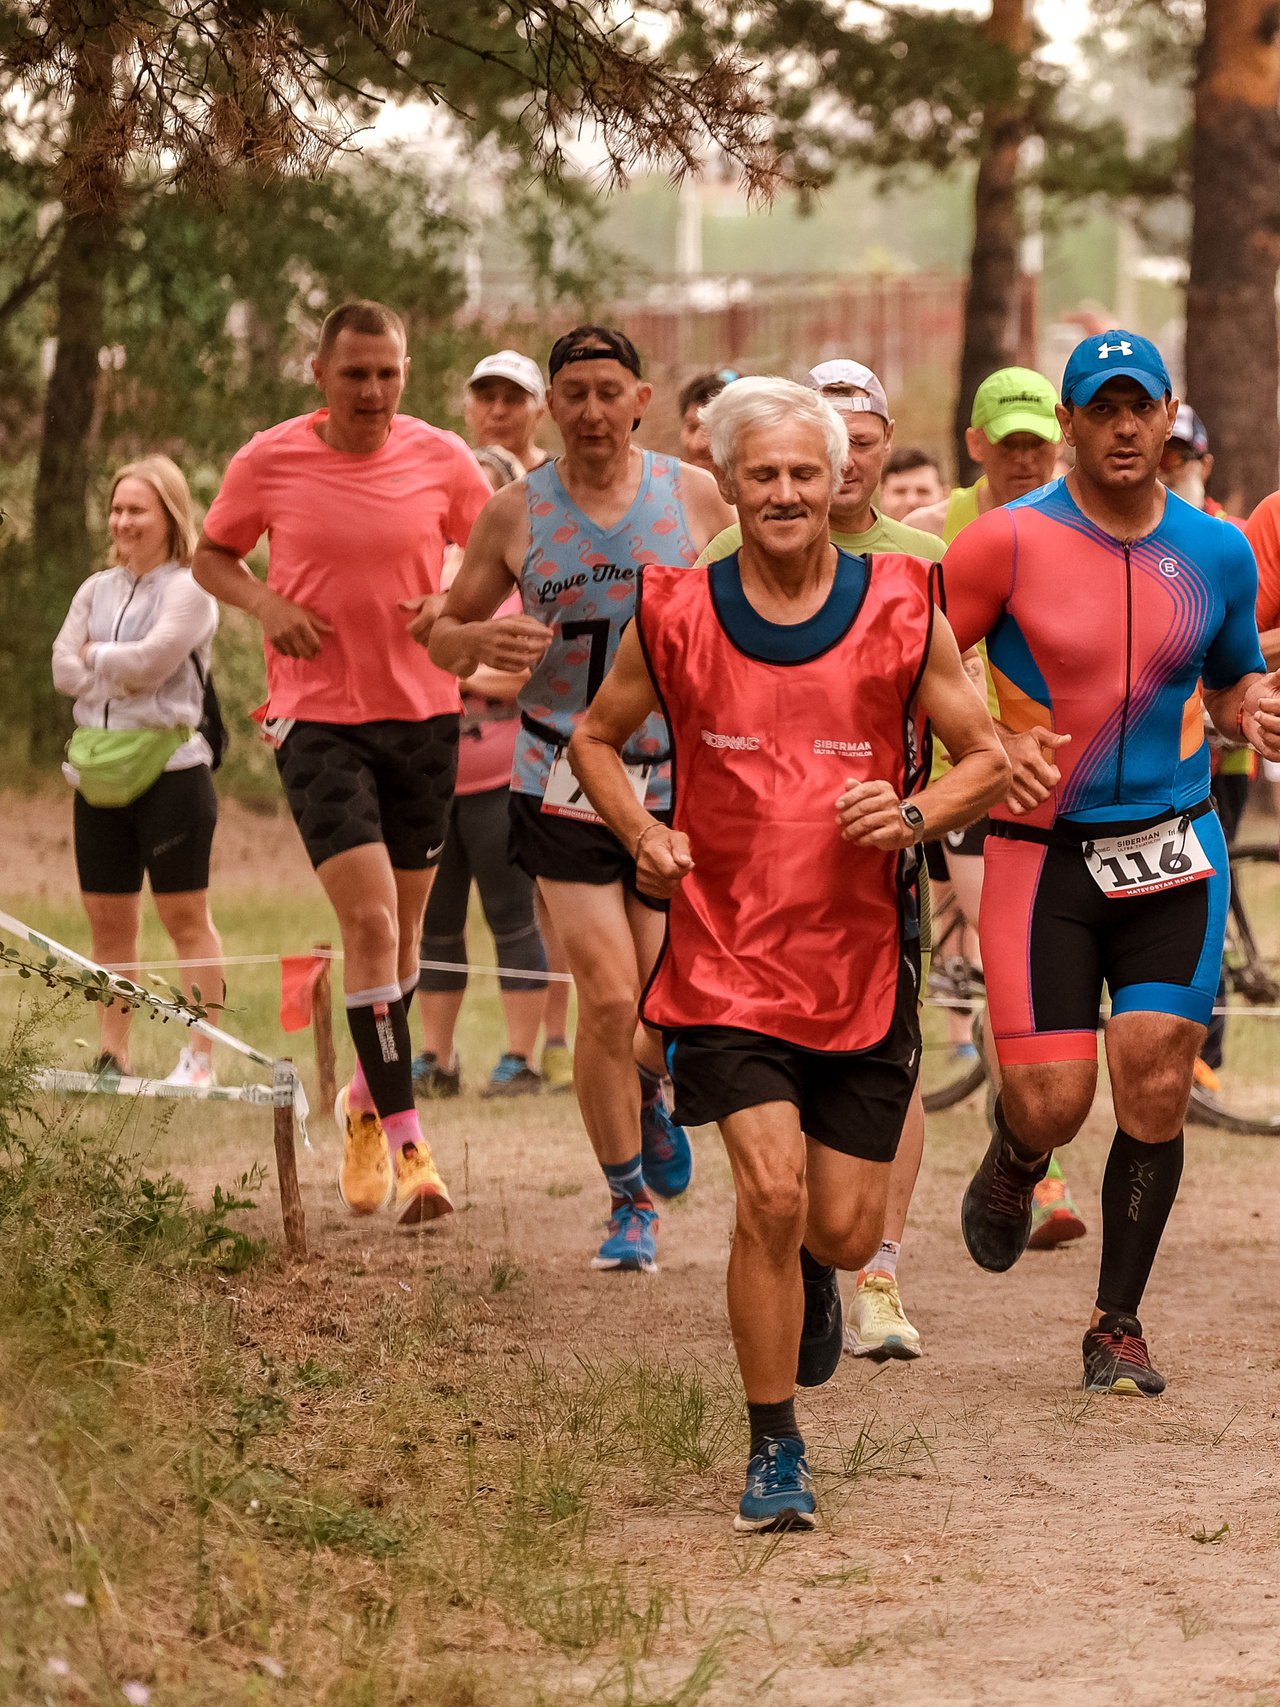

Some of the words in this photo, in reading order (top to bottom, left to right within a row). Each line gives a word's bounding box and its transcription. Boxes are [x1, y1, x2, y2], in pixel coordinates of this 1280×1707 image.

[537, 573, 588, 604] Love
[592, 563, 634, 582] The
[814, 739, 872, 750] SIBERMAN
[1117, 831, 1160, 848] SIBERMAN
[1101, 840, 1192, 888] 116
[1128, 1186, 1142, 1221] 2XU
